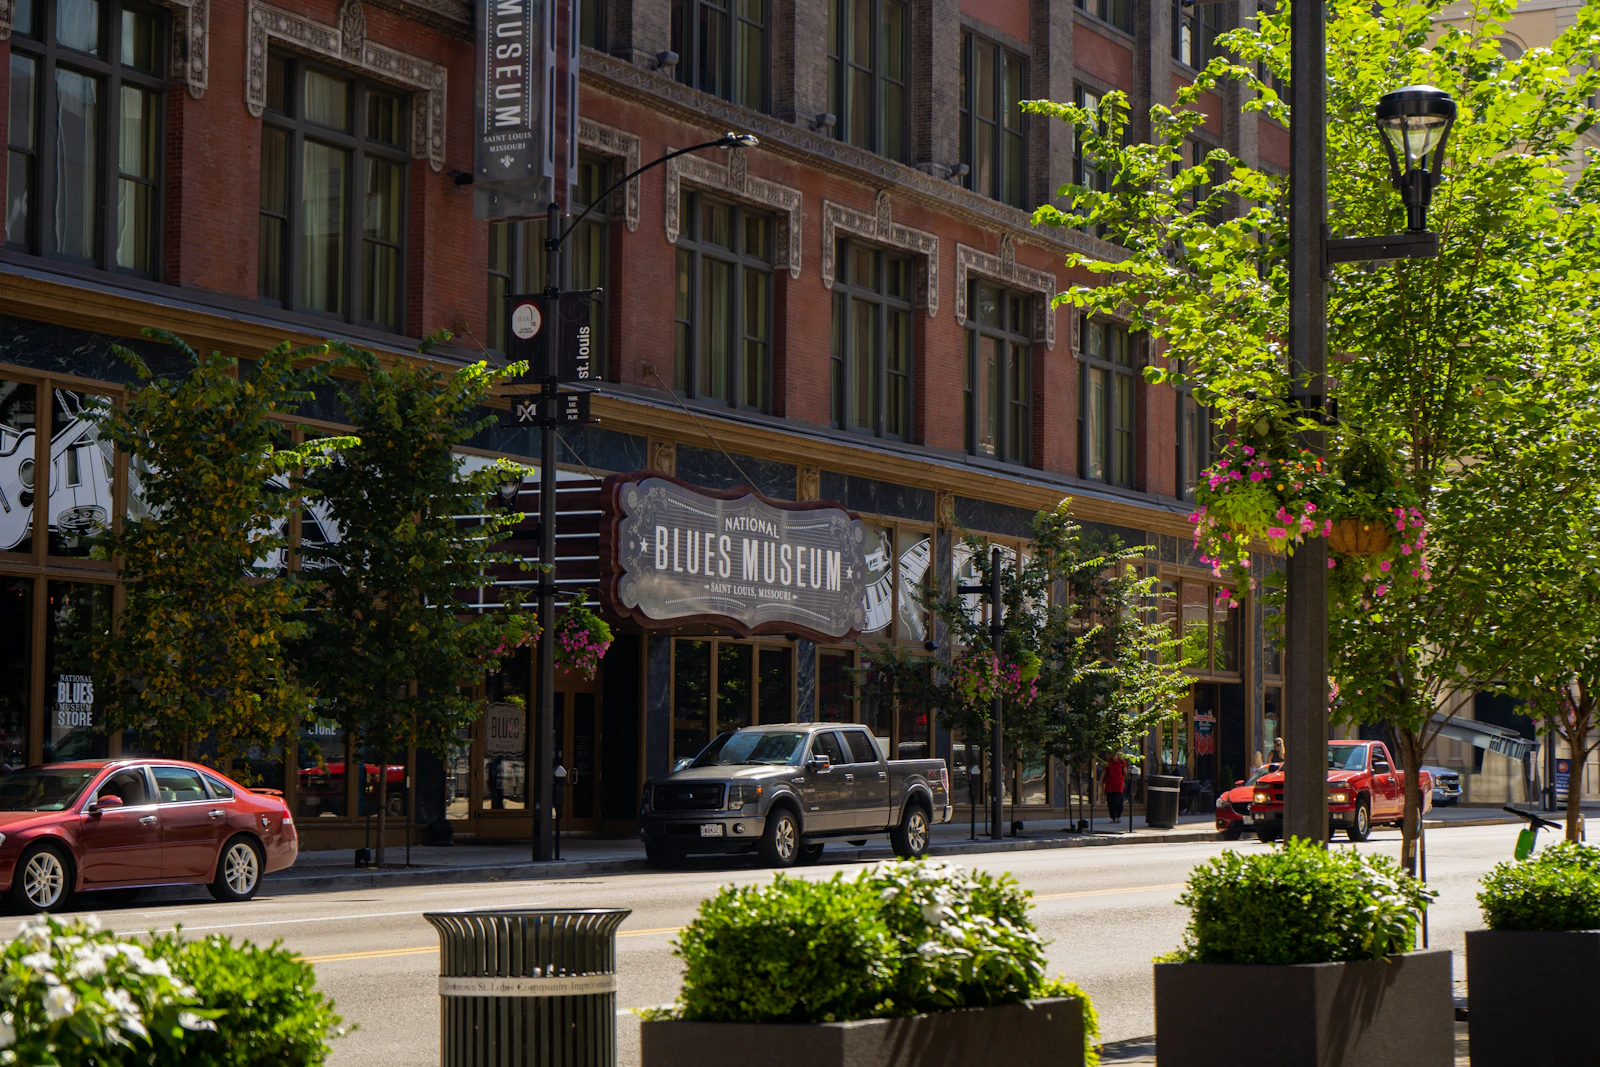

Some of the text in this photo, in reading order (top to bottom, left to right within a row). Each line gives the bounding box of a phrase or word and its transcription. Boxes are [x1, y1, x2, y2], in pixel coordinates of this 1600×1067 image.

[495, 0, 522, 127] MUSEUM
[483, 131, 532, 144] SAINT LOUIS
[489, 142, 526, 153] MISSOURI
[576, 326, 590, 379] st. louis
[725, 516, 780, 539] NATIONAL
[655, 525, 841, 592] BLUES MUSEUM
[710, 582, 792, 601] SAINT LOUIS, MISSOURI
[60, 674, 92, 682] NATIONAL
[58, 681, 94, 704] BLUES
[59, 703, 92, 711] MUSEUM
[58, 711, 92, 726] STORE
[491, 716, 520, 739] BLUES
[444, 981, 477, 992] Downtown
[517, 980, 569, 995] Community
